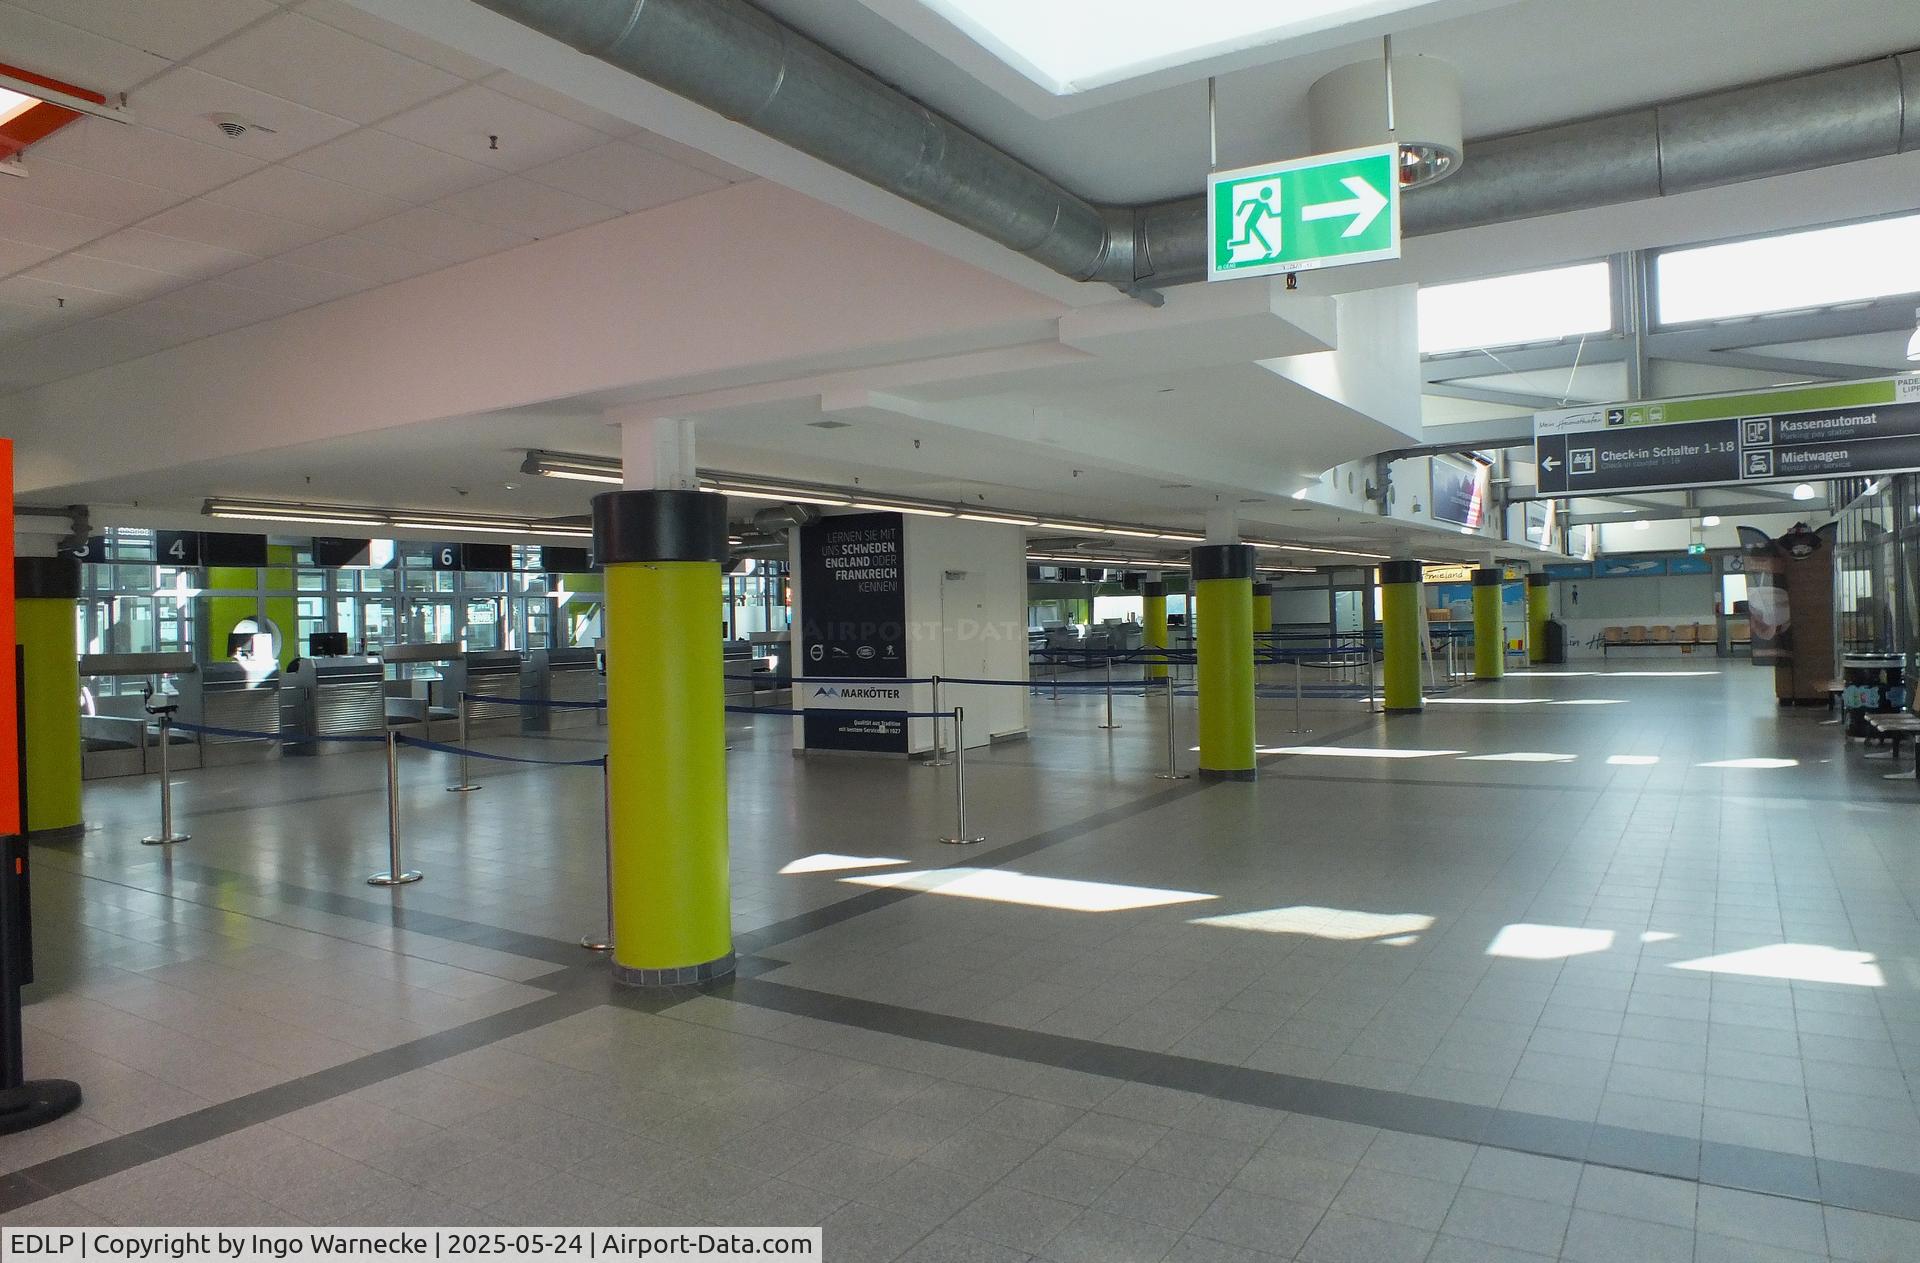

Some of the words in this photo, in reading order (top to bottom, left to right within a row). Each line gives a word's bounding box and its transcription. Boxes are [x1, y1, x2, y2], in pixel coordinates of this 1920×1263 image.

[1779, 413, 1877, 432] Kassenautomat
[1600, 450, 1649, 462] Check-in
[1653, 445, 1700, 457] Schalter
[1781, 450, 1848, 464] Mietwagen
[827, 531, 862, 543] LERNEN
[864, 530, 878, 541] SIE
[880, 528, 896, 540] MIT
[169, 539, 186, 560] 4
[822, 545, 840, 556] UNS
[441, 548, 453, 566] 6
[825, 556, 870, 568] ENGLAND
[872, 555, 897, 566] ODER
[835, 568, 897, 580] FRANKREICH
[841, 686, 900, 699] MARKÖTTER
